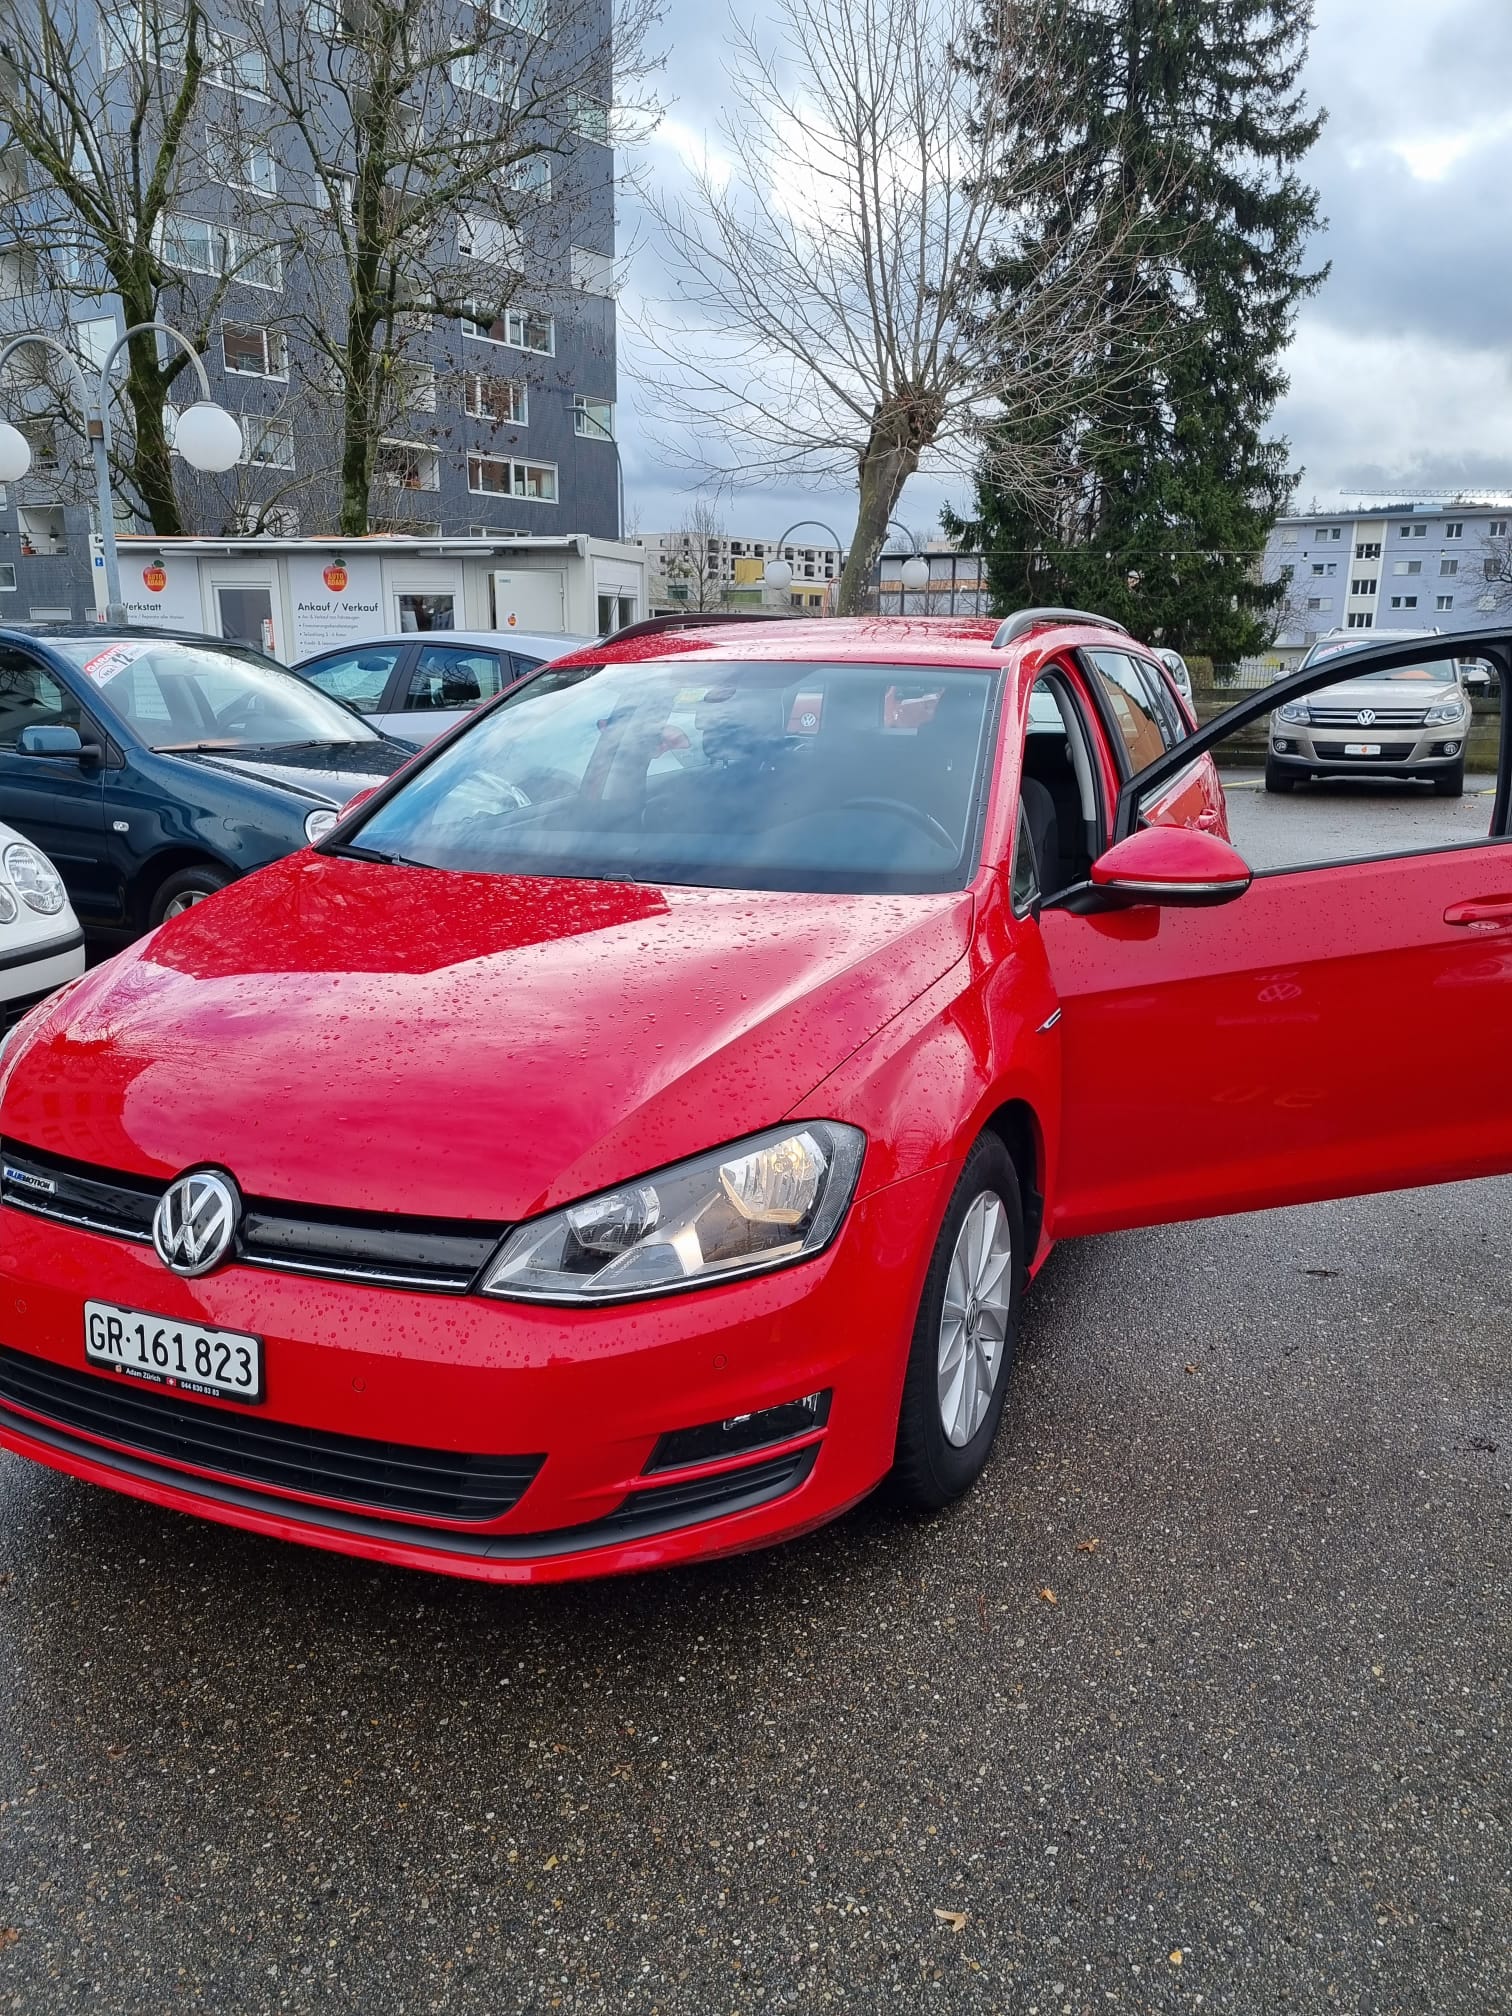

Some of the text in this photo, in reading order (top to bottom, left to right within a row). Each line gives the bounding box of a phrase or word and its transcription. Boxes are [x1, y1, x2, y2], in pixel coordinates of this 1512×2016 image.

[297, 602, 378, 613] Ankauf / Verkauf
[111, 653, 135, 666] 12
[126, 1368, 142, 1377] Adam
[142, 1373, 161, 1382] Zürich
